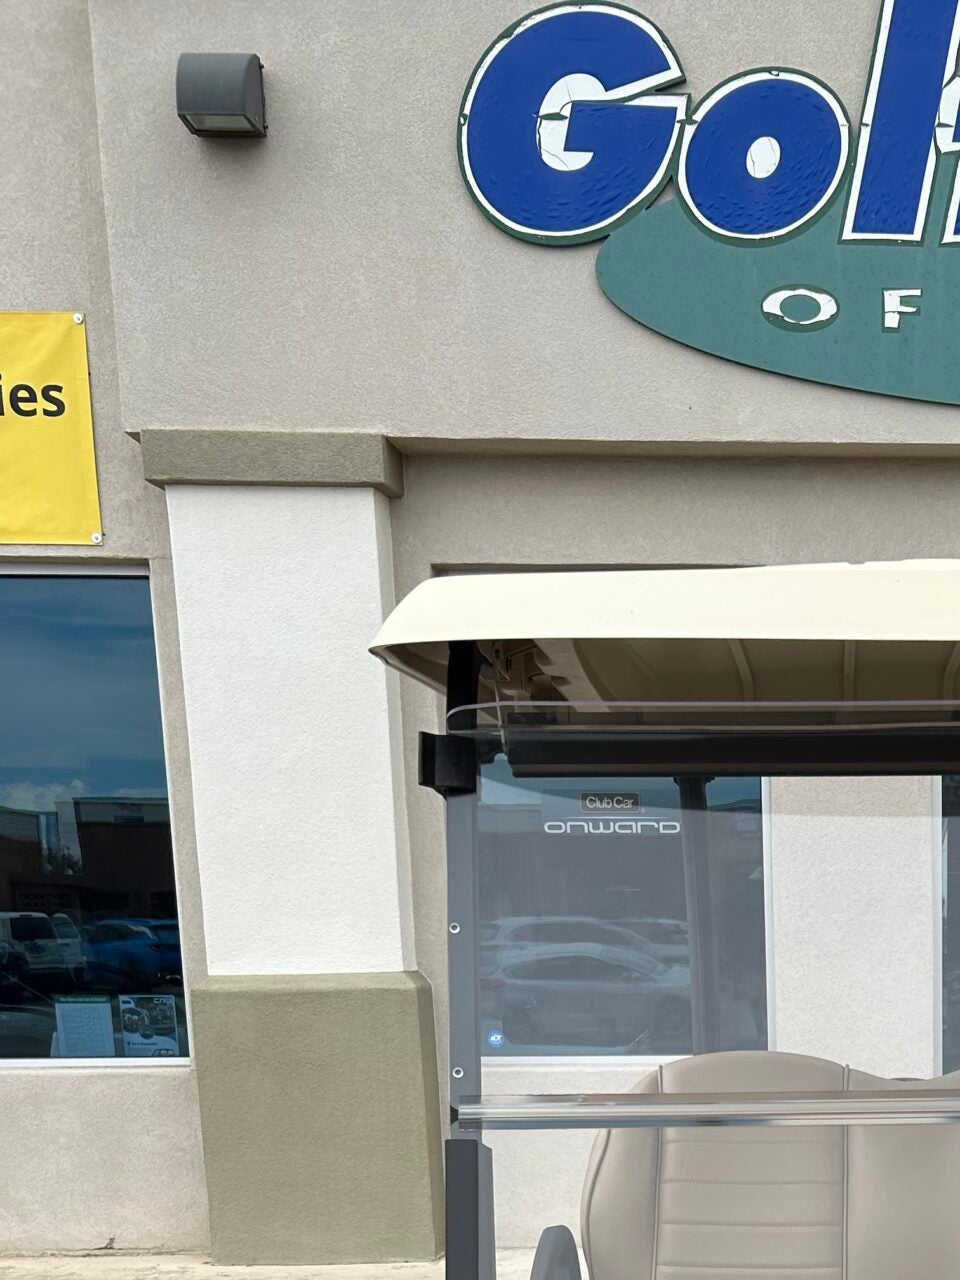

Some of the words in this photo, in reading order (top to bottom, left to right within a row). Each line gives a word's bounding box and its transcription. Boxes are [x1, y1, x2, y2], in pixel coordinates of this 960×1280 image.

[763, 288, 922, 329] OF
[586, 796, 612, 808] Club
[613, 796, 634, 808] Car
